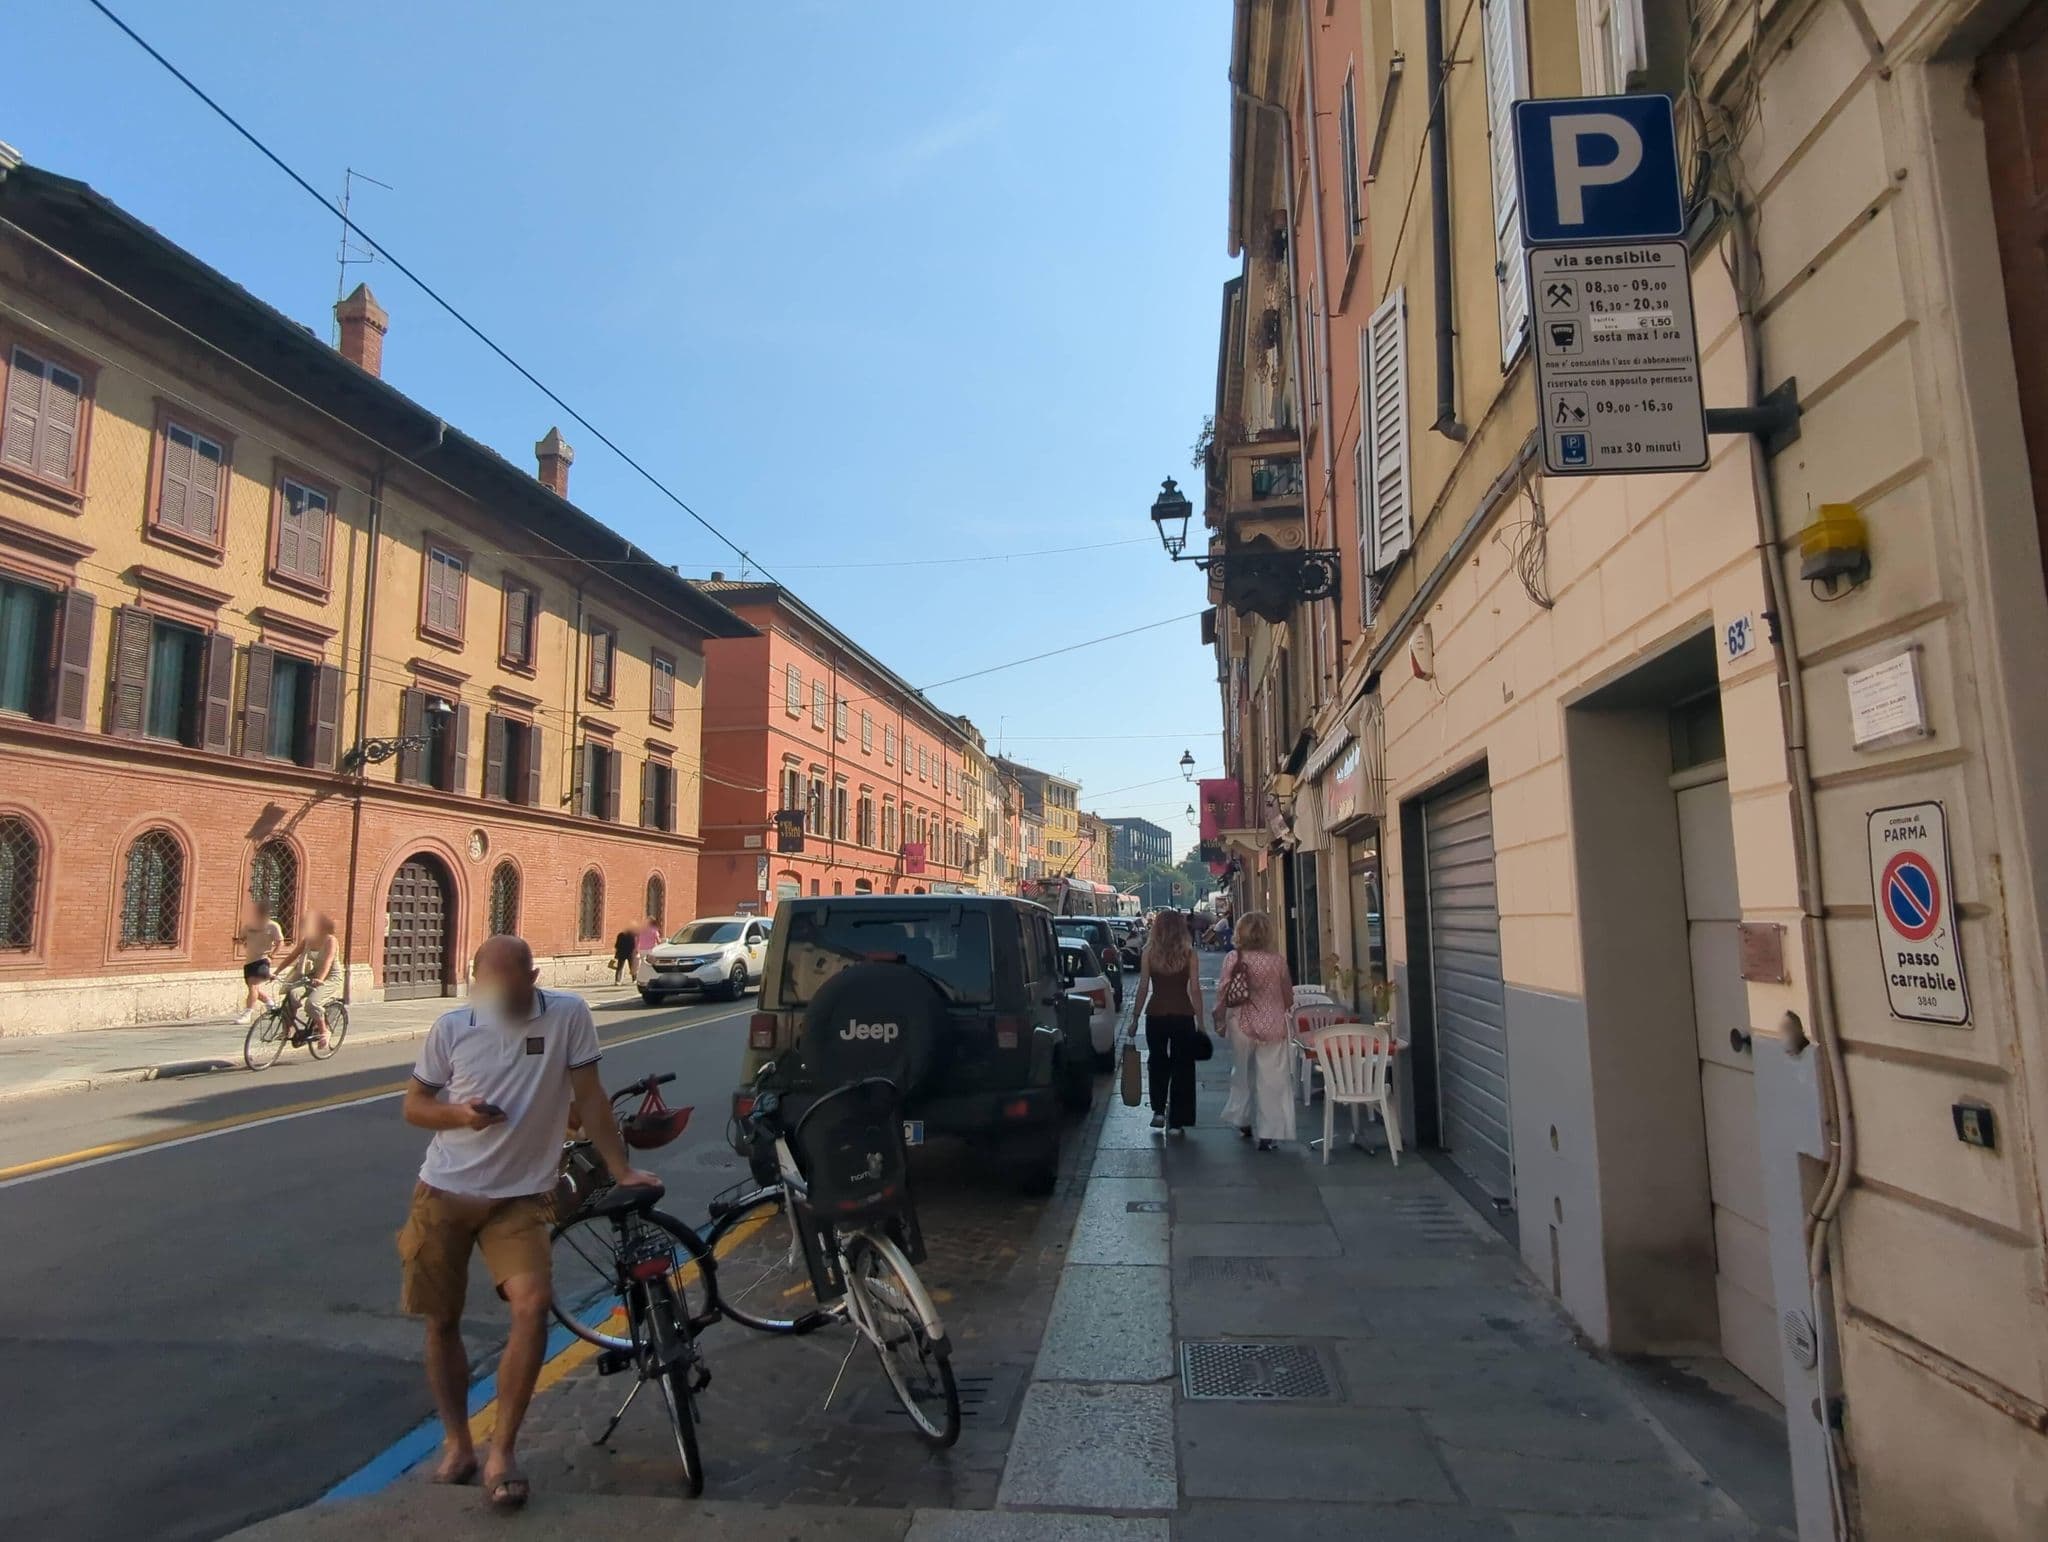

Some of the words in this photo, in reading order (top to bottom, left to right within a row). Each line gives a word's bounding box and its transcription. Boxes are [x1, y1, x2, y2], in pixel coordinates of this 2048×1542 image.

[1550, 113, 1643, 225] P
[1554, 254, 1578, 267] via
[1584, 250, 1662, 266] sensibile
[1631, 279, 1667, 292] 09.00
[1633, 298, 1669, 311] 20.30
[1593, 331, 1622, 343] sosta
[1627, 332, 1649, 342] max
[1662, 330, 1681, 340] ora
[1547, 378, 1589, 389] riservato
[1590, 379, 1607, 387] con
[1609, 376, 1648, 388] apposito
[1650, 375, 1693, 386] permesso
[1596, 400, 1631, 414] 09.00
[1641, 399, 1673, 412] 16.30
[1600, 445, 1623, 454] max
[1626, 442, 1641, 453] 30
[1646, 440, 1681, 452] minuti
[1884, 825, 1927, 842] PARMA
[1897, 952, 1940, 968] passo
[1891, 972, 1956, 991] carrabile
[839, 1019, 899, 1043] Jeep
